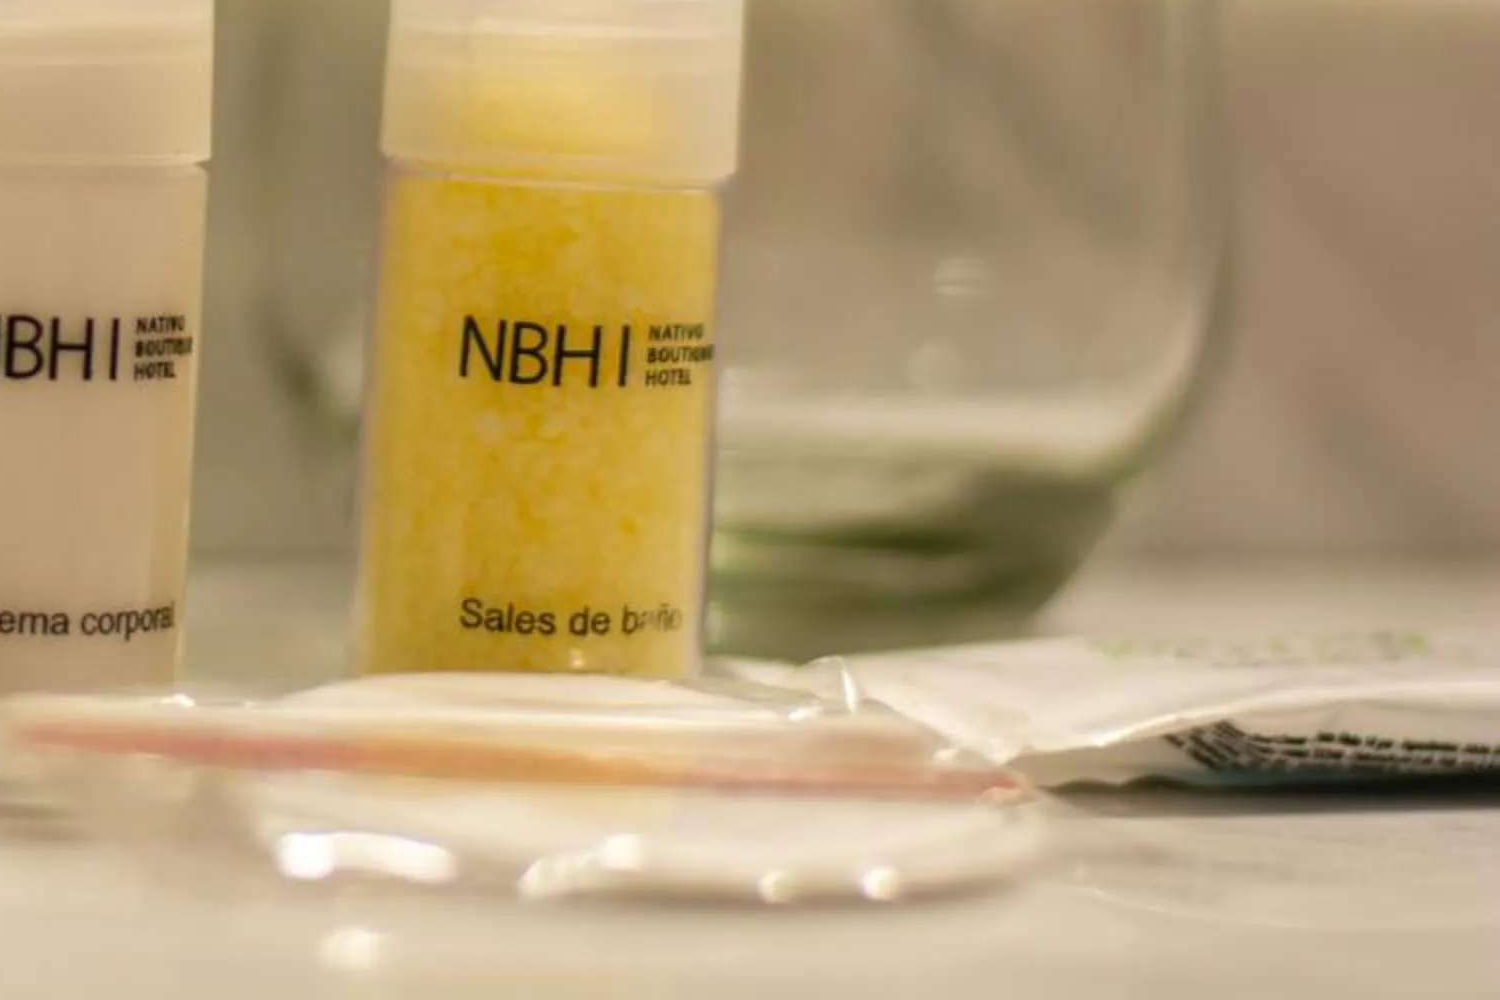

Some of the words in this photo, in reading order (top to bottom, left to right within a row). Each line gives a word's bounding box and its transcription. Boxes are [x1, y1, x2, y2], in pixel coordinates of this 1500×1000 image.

[135, 337, 193, 358] BOUTI
[646, 344, 716, 364] BOUTI
[133, 361, 177, 381] HOTEL
[645, 368, 692, 387] HOTEL
[459, 597, 557, 636] Sales
[568, 604, 612, 637] de
